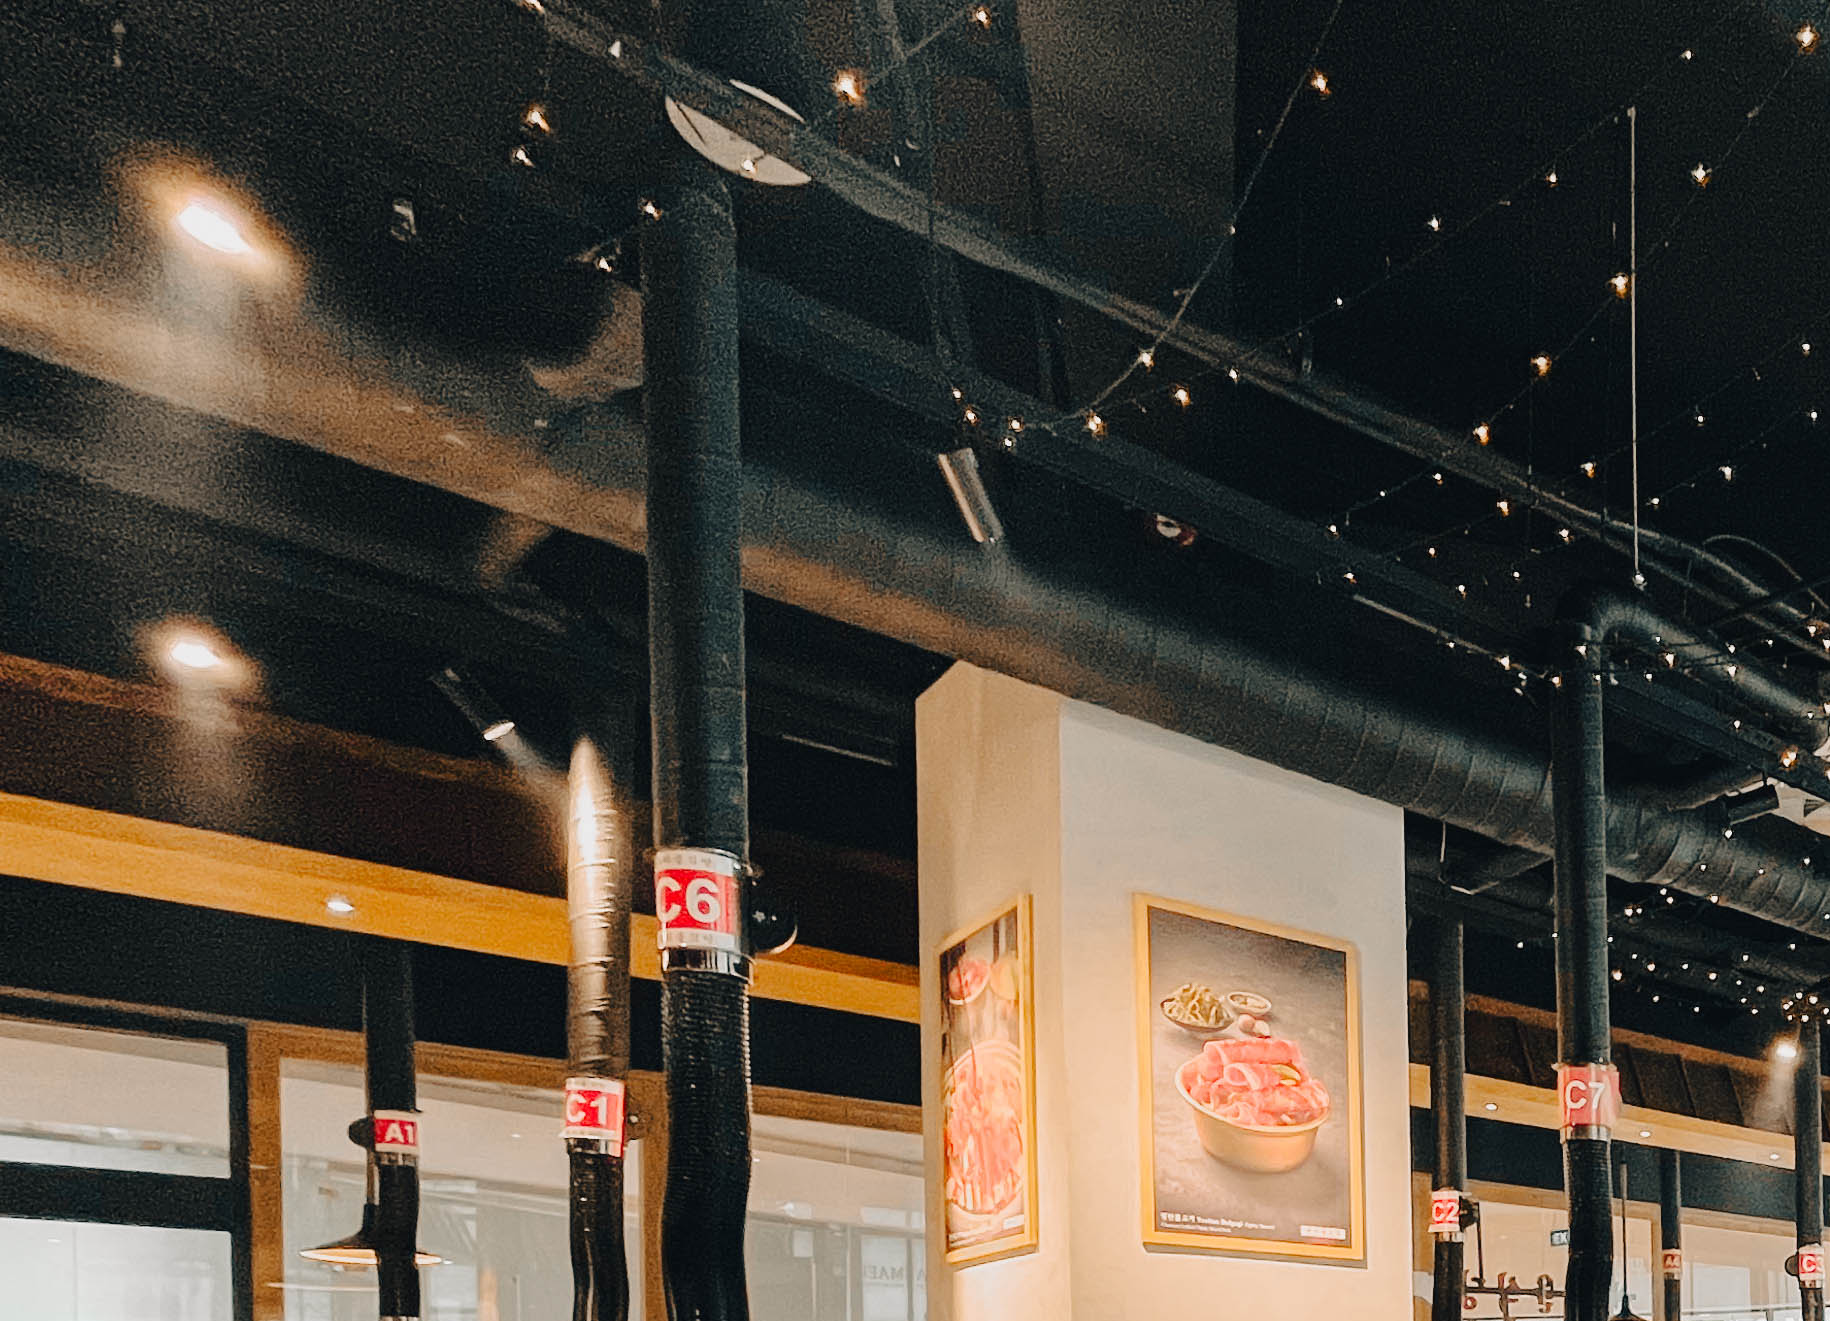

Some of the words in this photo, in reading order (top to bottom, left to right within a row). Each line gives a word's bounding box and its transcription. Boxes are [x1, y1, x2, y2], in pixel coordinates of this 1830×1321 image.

[656, 876, 721, 923] C6
[566, 1093, 608, 1126] C1
[1565, 1079, 1605, 1110] C7
[384, 1122, 416, 1144] A1
[1431, 1201, 1460, 1223] C2
